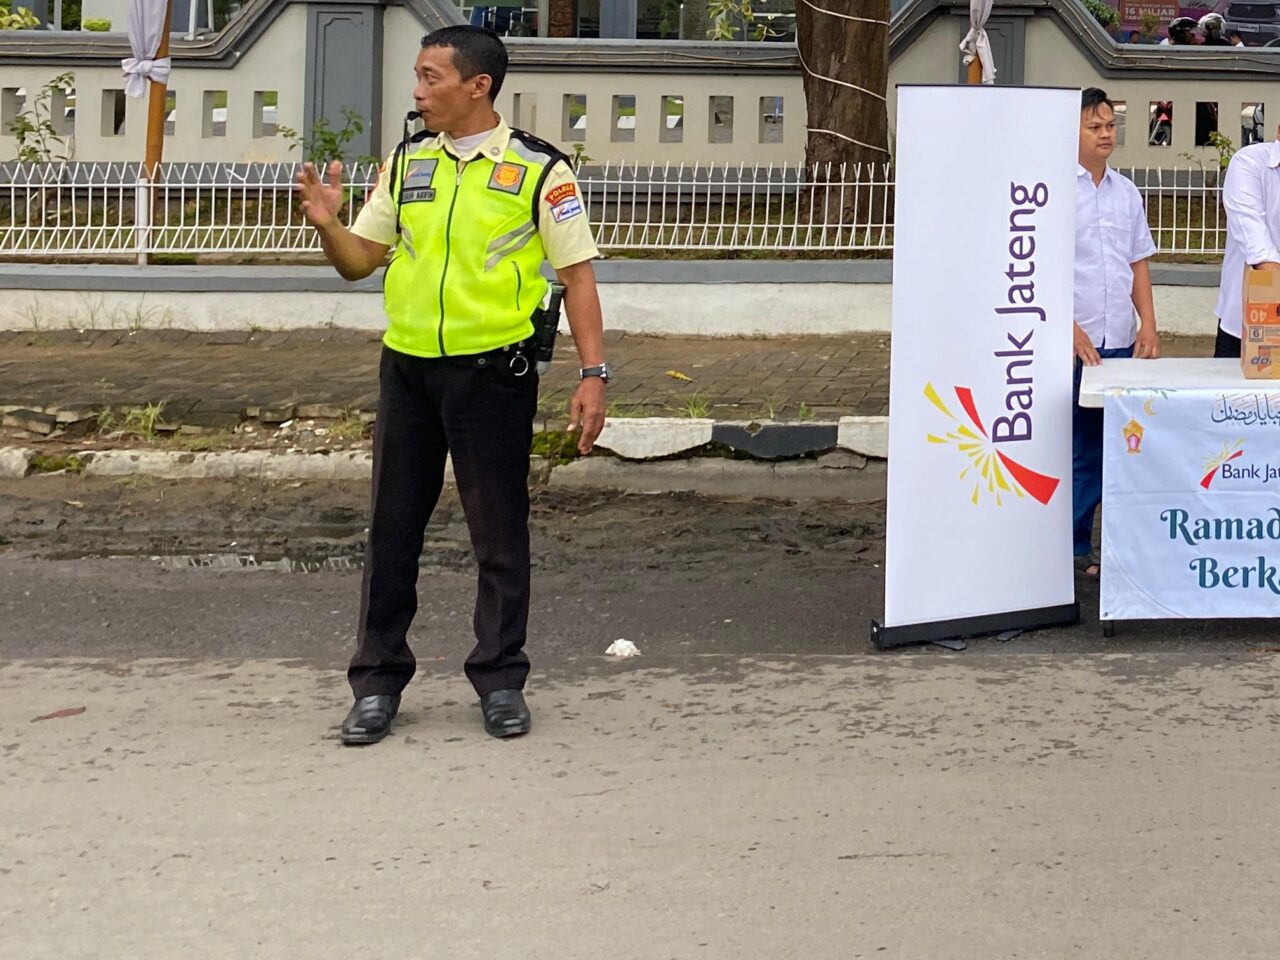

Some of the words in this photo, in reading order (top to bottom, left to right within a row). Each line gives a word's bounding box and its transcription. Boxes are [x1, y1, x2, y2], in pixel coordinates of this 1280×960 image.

[1124, 7, 1136, 16] 16
[994, 181, 1049, 322] Jateng
[1250, 309, 1268, 322] 40
[991, 328, 1034, 444] Bank
[1221, 464, 1260, 479] Bank
